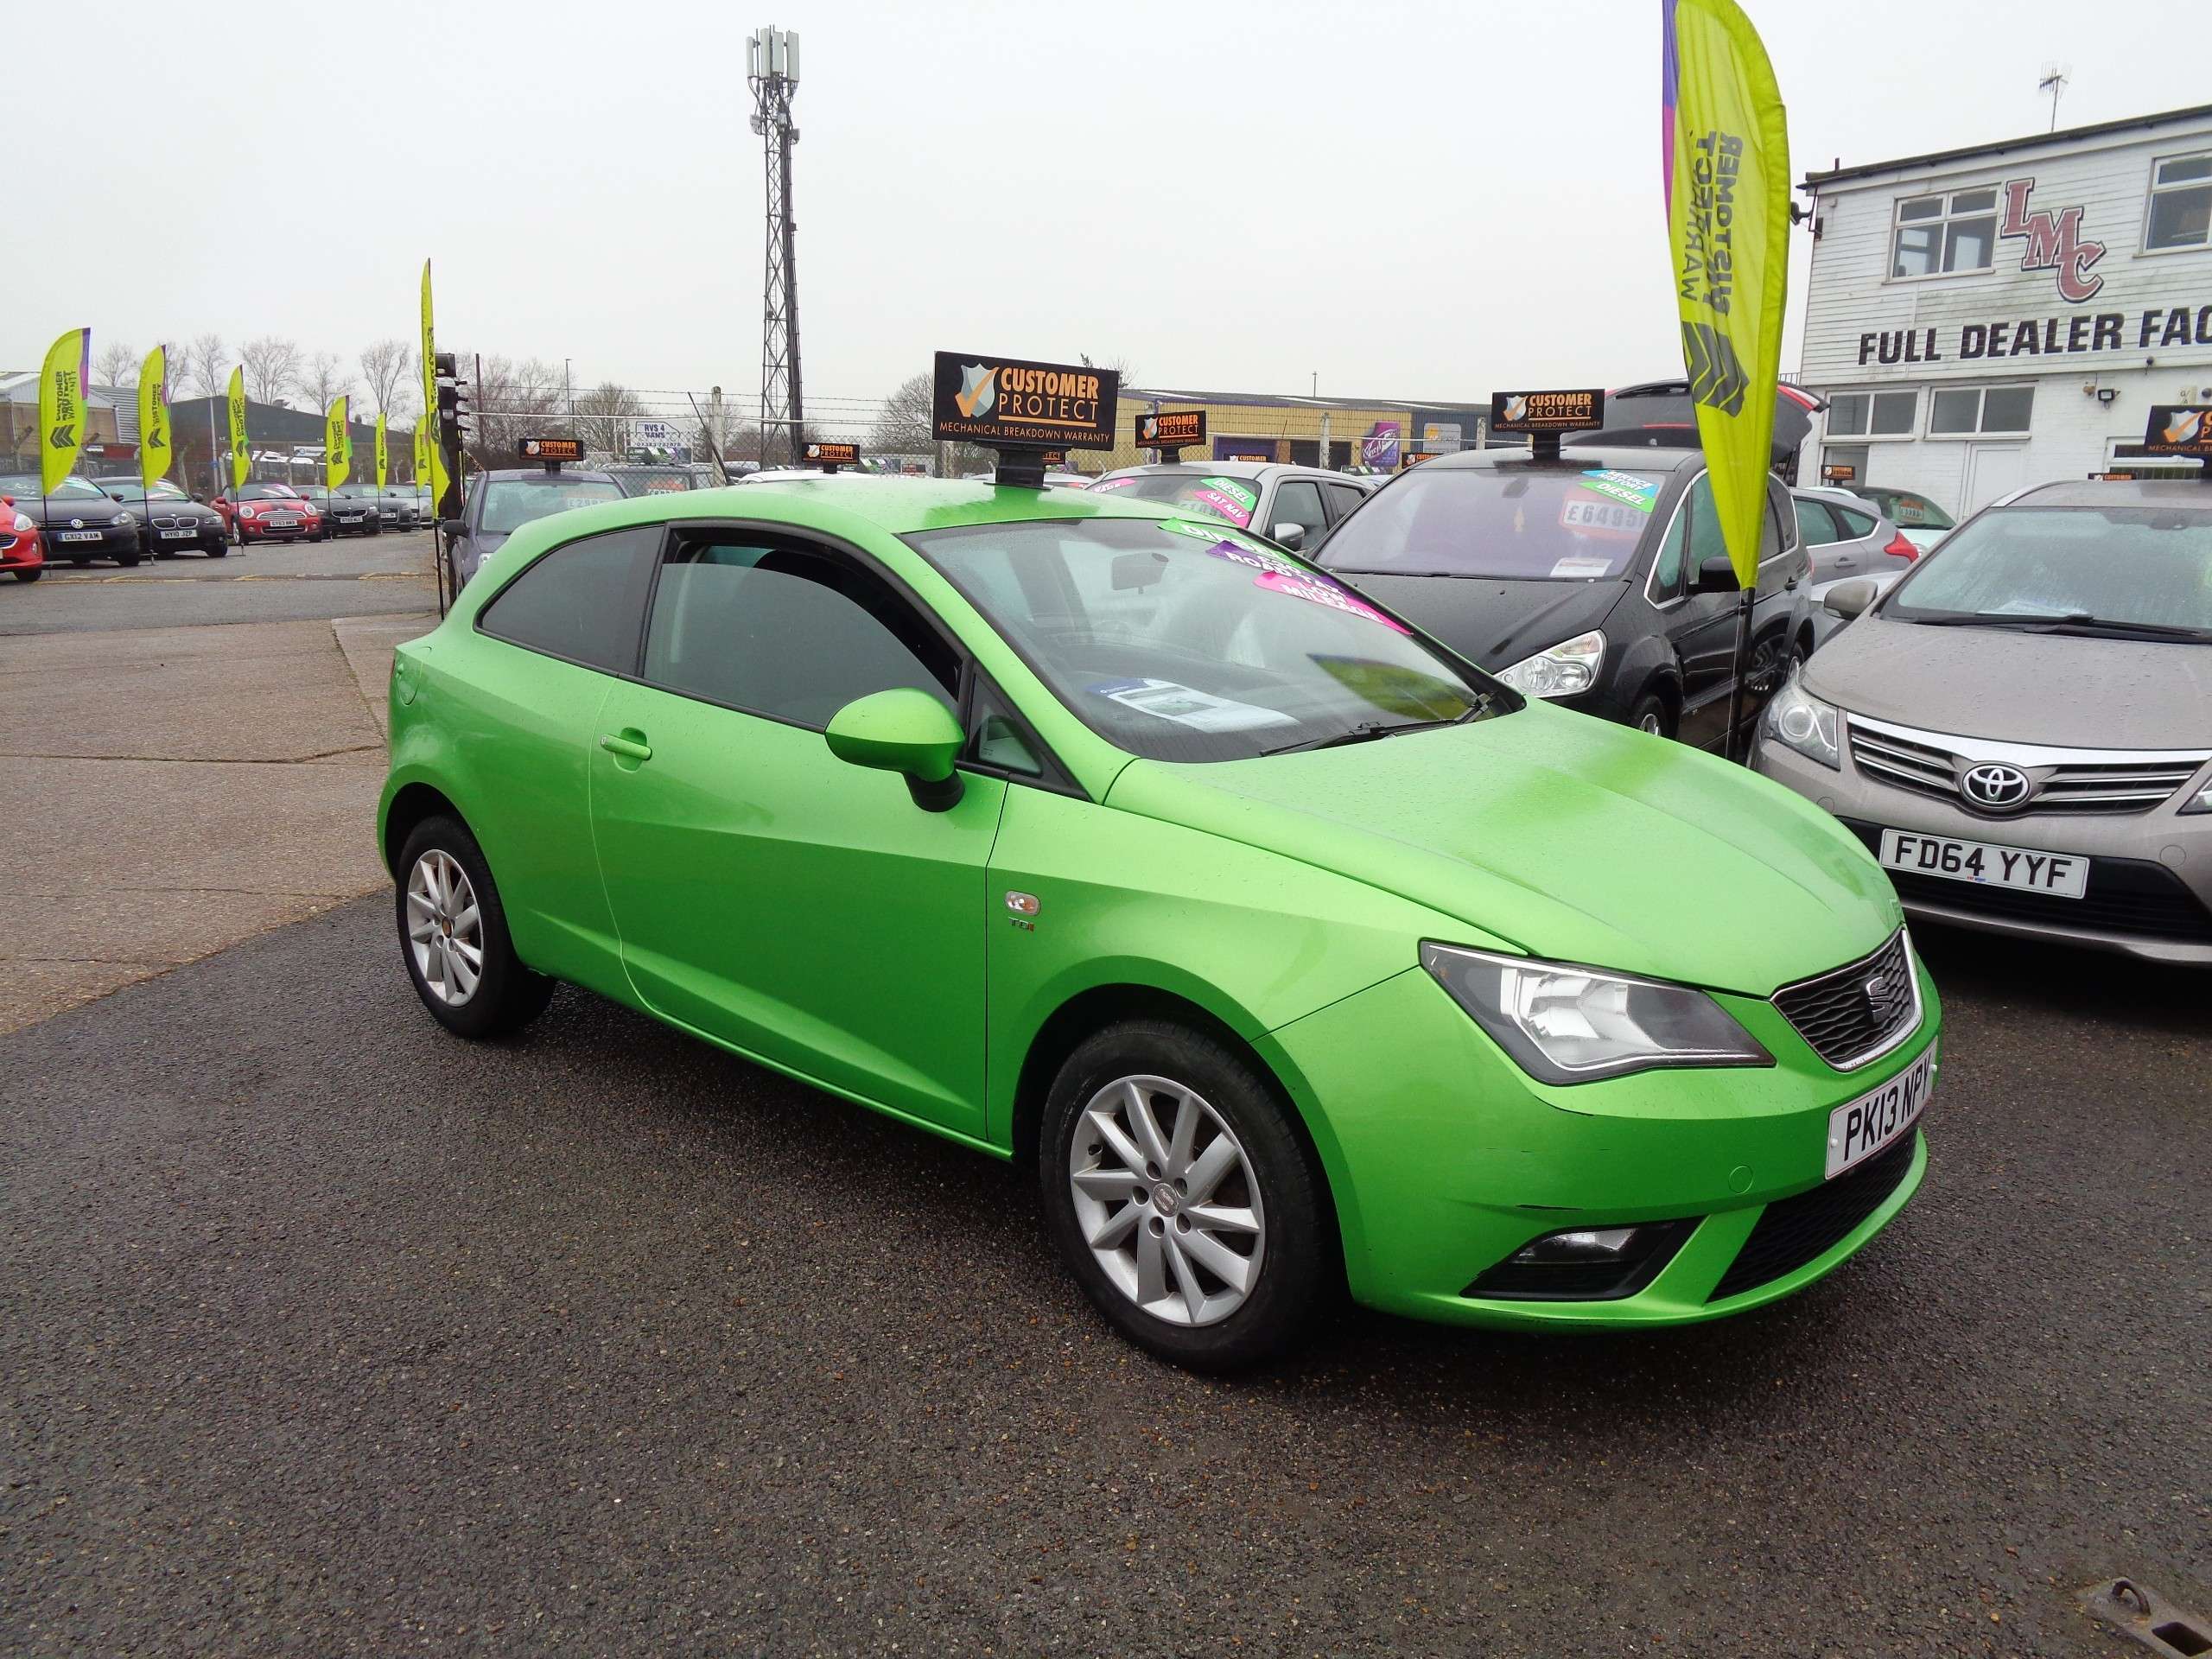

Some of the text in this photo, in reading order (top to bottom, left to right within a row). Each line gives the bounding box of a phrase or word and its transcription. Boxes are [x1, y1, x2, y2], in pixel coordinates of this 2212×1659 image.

[1999, 176, 2107, 303] LMC
[1858, 327, 1942, 365] FULL
[1959, 312, 2126, 359] DEALER
[1001, 367, 1099, 400] CUSTOMER
[998, 392, 1099, 421] PROTECT
[1528, 405, 1592, 417] PROTECT
[1529, 393, 1592, 406] CUSTOMER
[644, 423, 665, 432] RVS 4
[1158, 424, 1198, 435] PROTECT
[1159, 415, 1198, 426] CUSTOMER
[939, 422, 1110, 443] MECHANICAL BREAKDOWN WARRANTY
[1215, 480, 1249, 503] DIESEL
[1596, 482, 1646, 505] DIESEL
[1206, 492, 1247, 518] SAT NAV
[1894, 835, 2073, 888] FD64 YYF
[1843, 1052, 1932, 1162] PK13 NPY
